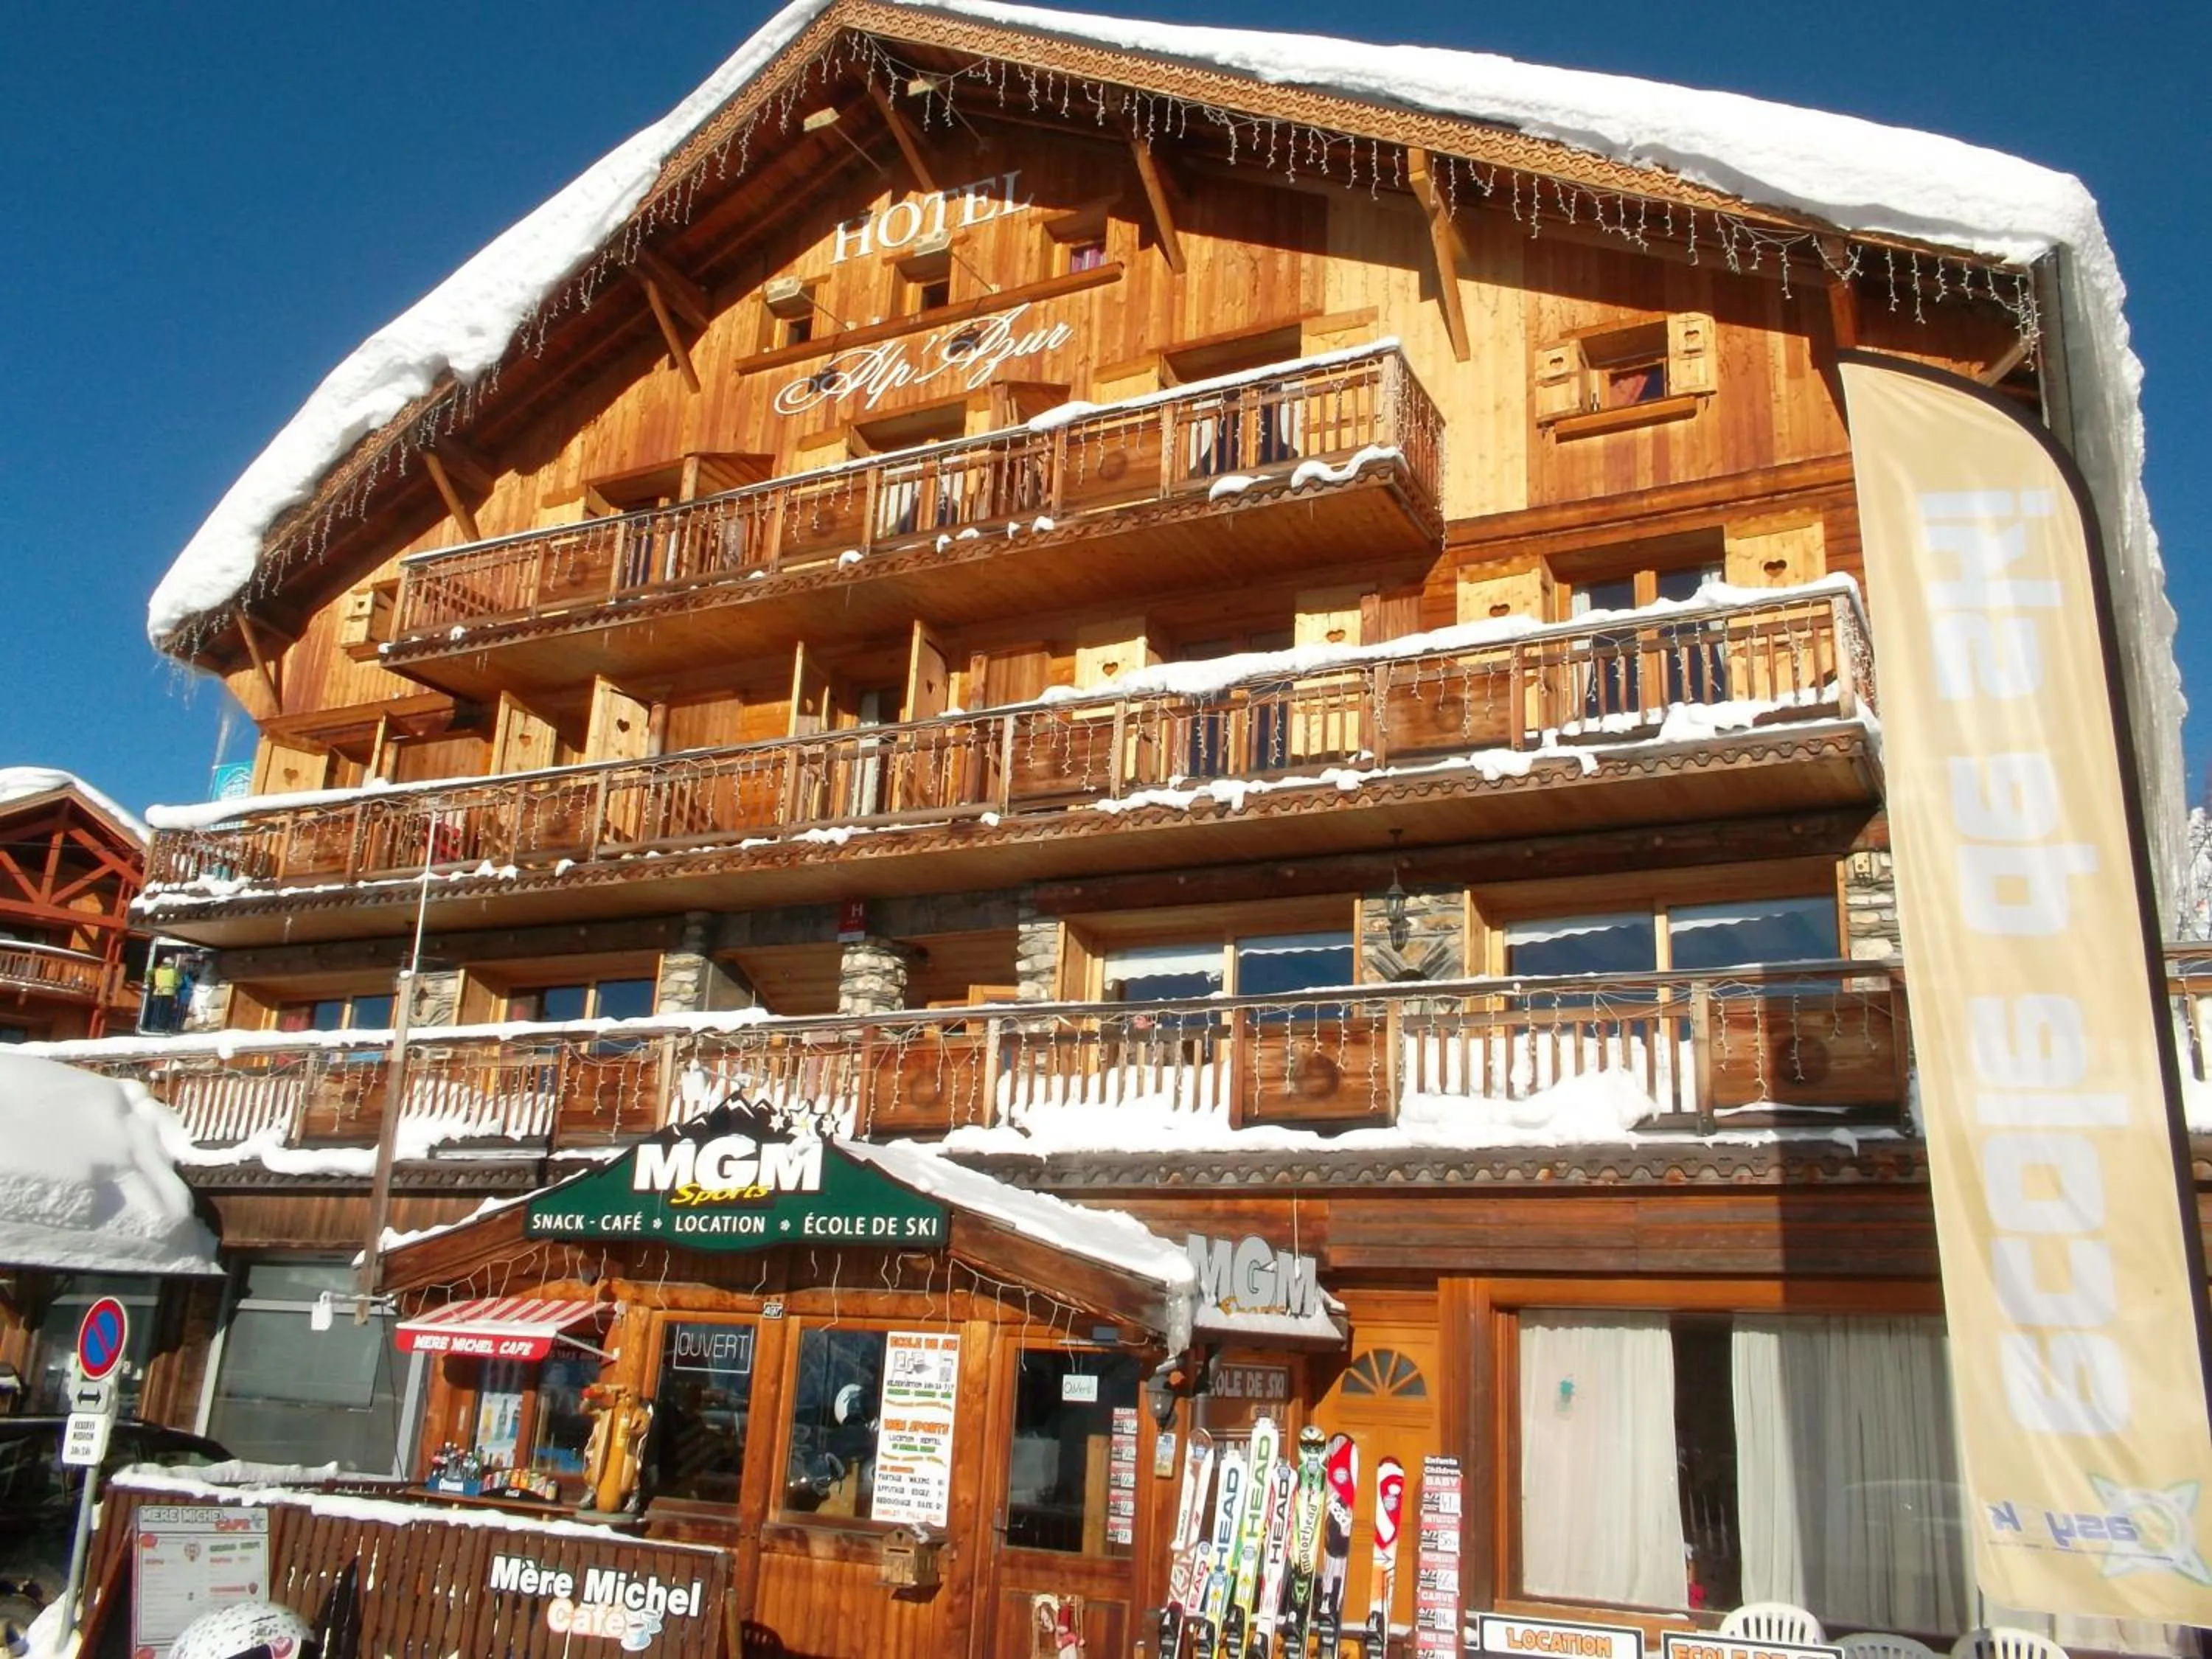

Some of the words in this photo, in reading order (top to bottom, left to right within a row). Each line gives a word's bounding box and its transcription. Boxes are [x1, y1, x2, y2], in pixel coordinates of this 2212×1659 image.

[830, 170, 1035, 265] HOTEL
[851, 902, 864, 917] H
[633, 1133, 824, 1191] MGM
[670, 1183, 771, 1205] Sports
[532, 1214, 584, 1230] SNACK
[601, 1211, 643, 1231] CAFÉ
[675, 1214, 765, 1233] LOCATION
[804, 1211, 866, 1235] ÉCOLE
[872, 1217, 897, 1235] DE
[905, 1217, 937, 1236] SKI
[1188, 1234, 1316, 1316] MGM
[678, 1332, 749, 1360] OUVERT
[1246, 1371, 1263, 1399] DE
[1246, 1436, 1270, 1537] HEAD
[1215, 1467, 1239, 1572] HEAD
[1270, 1478, 1290, 1564] HEAD
[489, 1555, 574, 1599] Mère
[583, 1568, 702, 1618] Michel
[1506, 1627, 1613, 1658] LOCATION
